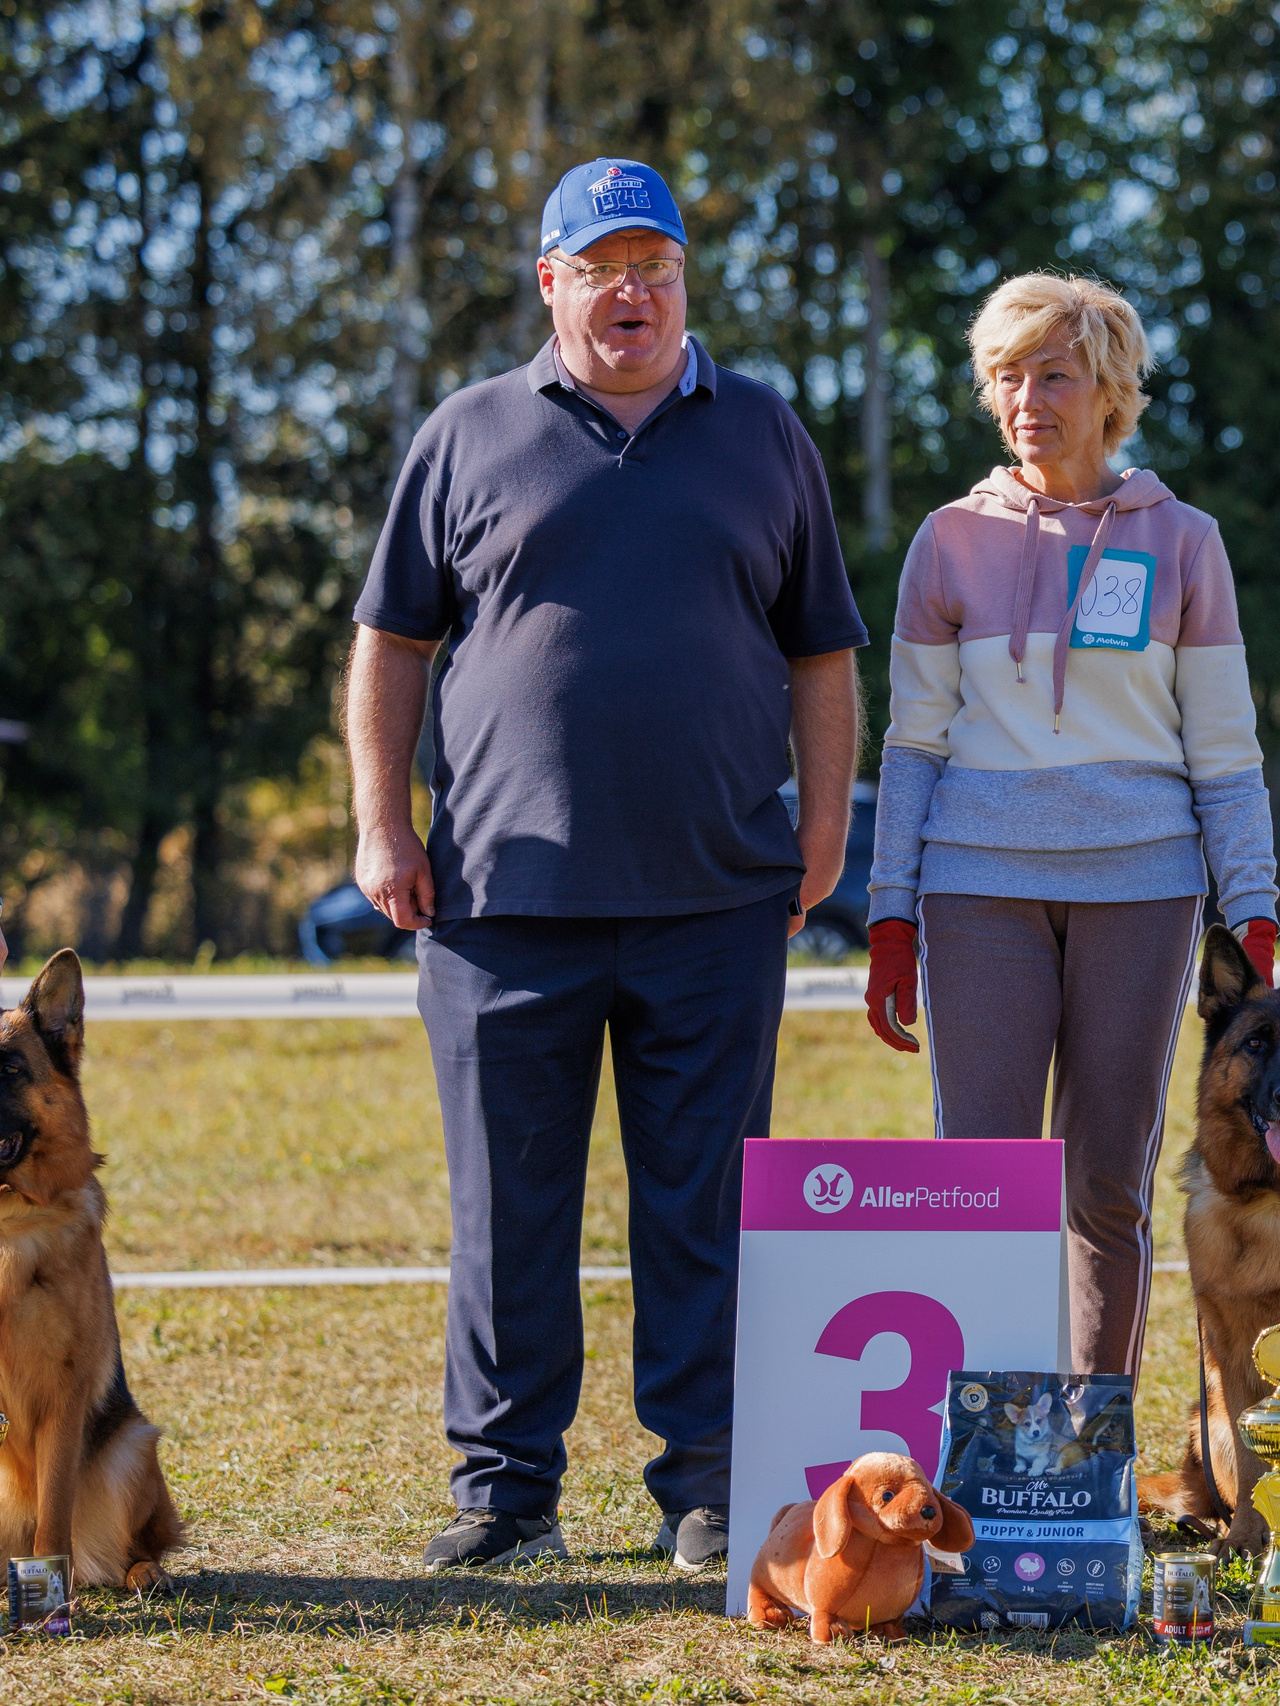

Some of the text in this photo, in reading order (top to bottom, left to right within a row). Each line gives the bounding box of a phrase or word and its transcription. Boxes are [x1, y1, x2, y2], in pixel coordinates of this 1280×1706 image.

[592, 189, 651, 215] 1946
[1096, 636, 1129, 647] Metwin
[859, 1186, 1000, 1209] AllerPetfood
[804, 1290, 965, 1501] 3
[981, 1487, 1092, 1508] BUFFALO
[996, 1507, 1028, 1515] Premium
[1028, 1508, 1056, 1517] Quality
[981, 1525, 1085, 1537] PUPPY & JUNIOR
[1027, 1585, 1035, 1593] kg
[1164, 1624, 1187, 1635] ADULT
